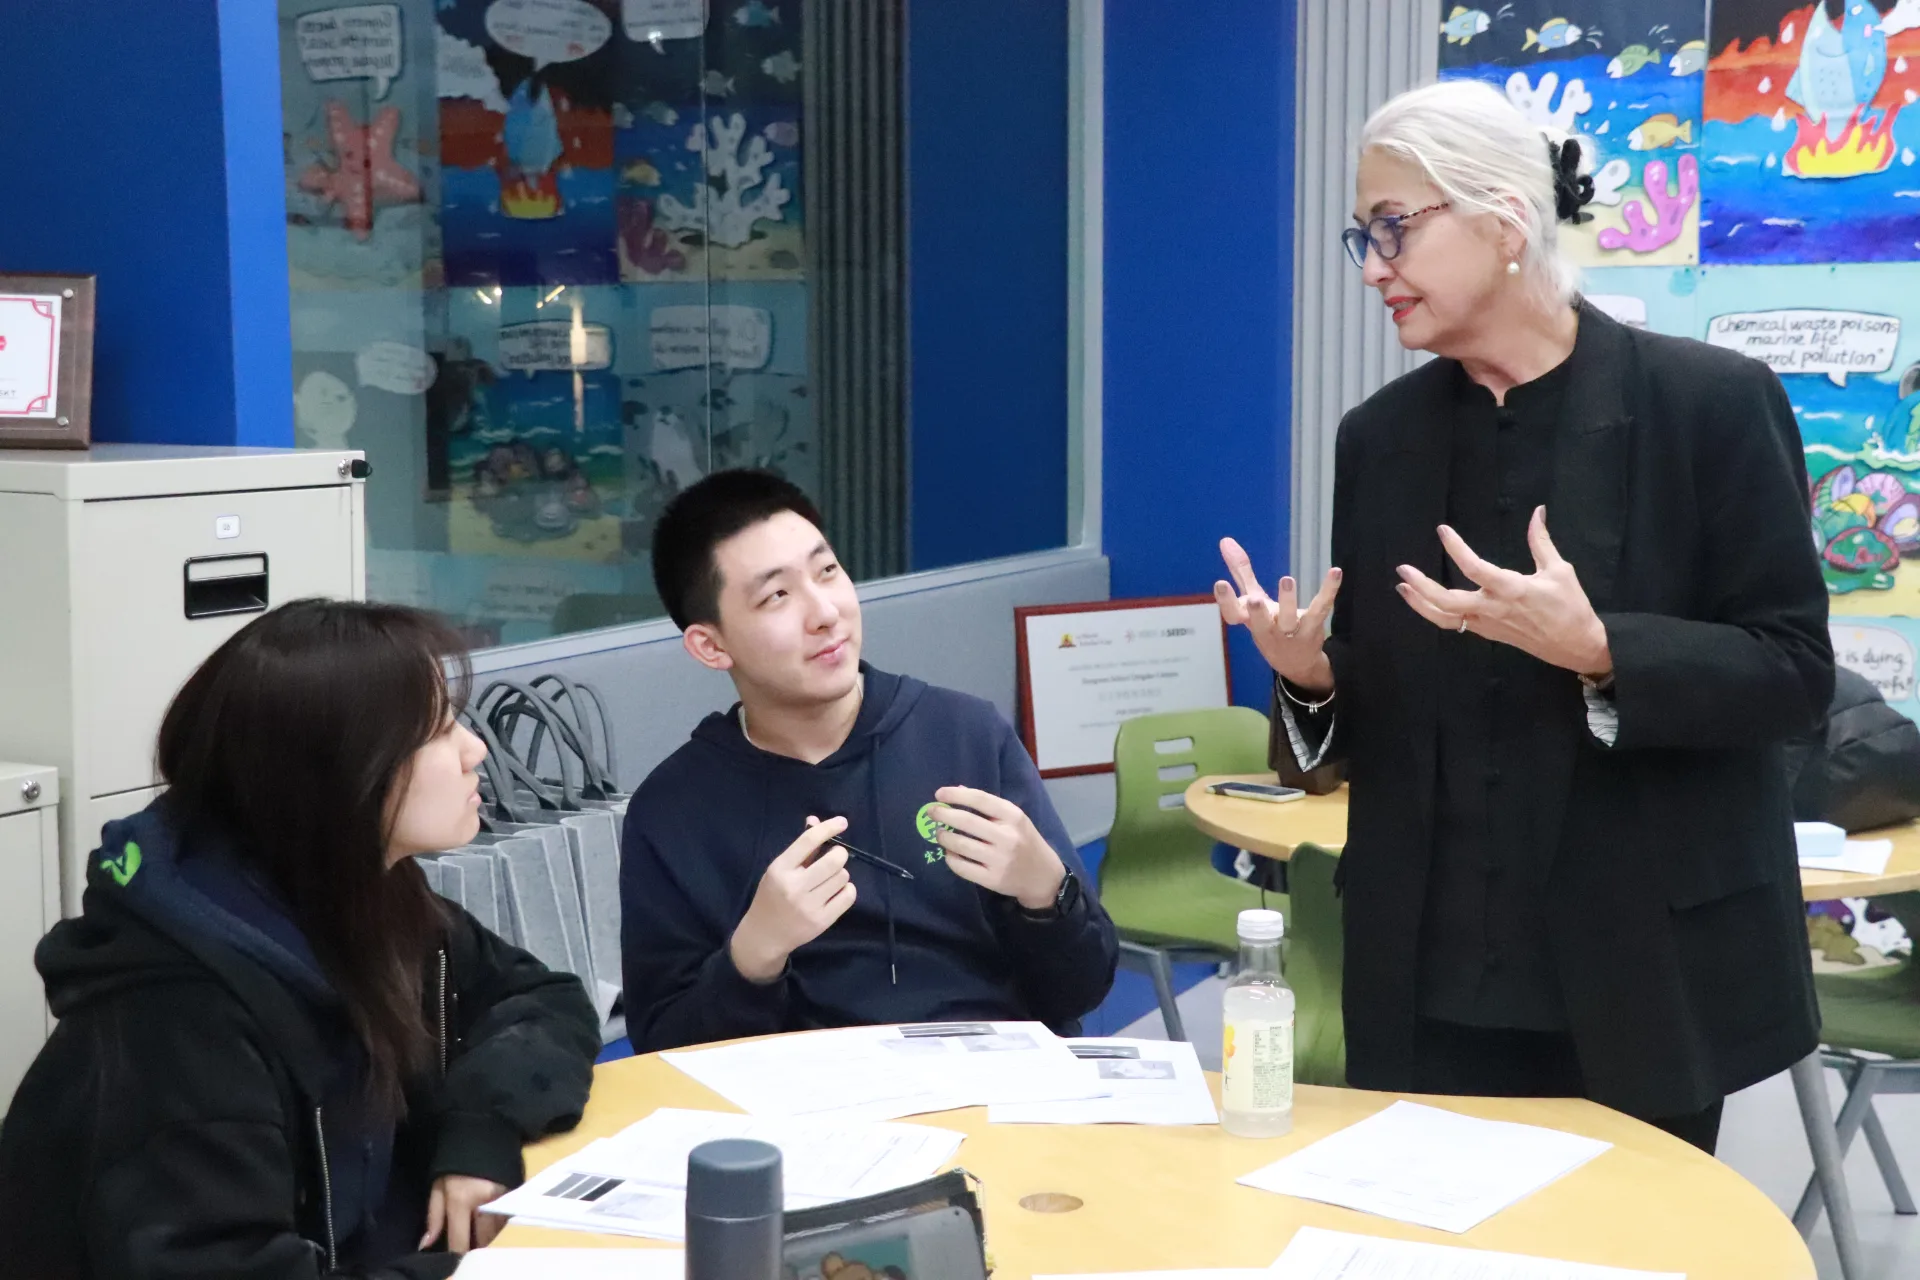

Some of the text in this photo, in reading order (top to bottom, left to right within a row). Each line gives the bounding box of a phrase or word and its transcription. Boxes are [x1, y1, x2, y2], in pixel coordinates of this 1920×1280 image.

[1717, 316, 1900, 336] Chemical waste poisons
[1746, 334, 1806, 346] marine
[1845, 648, 1859, 662] is
